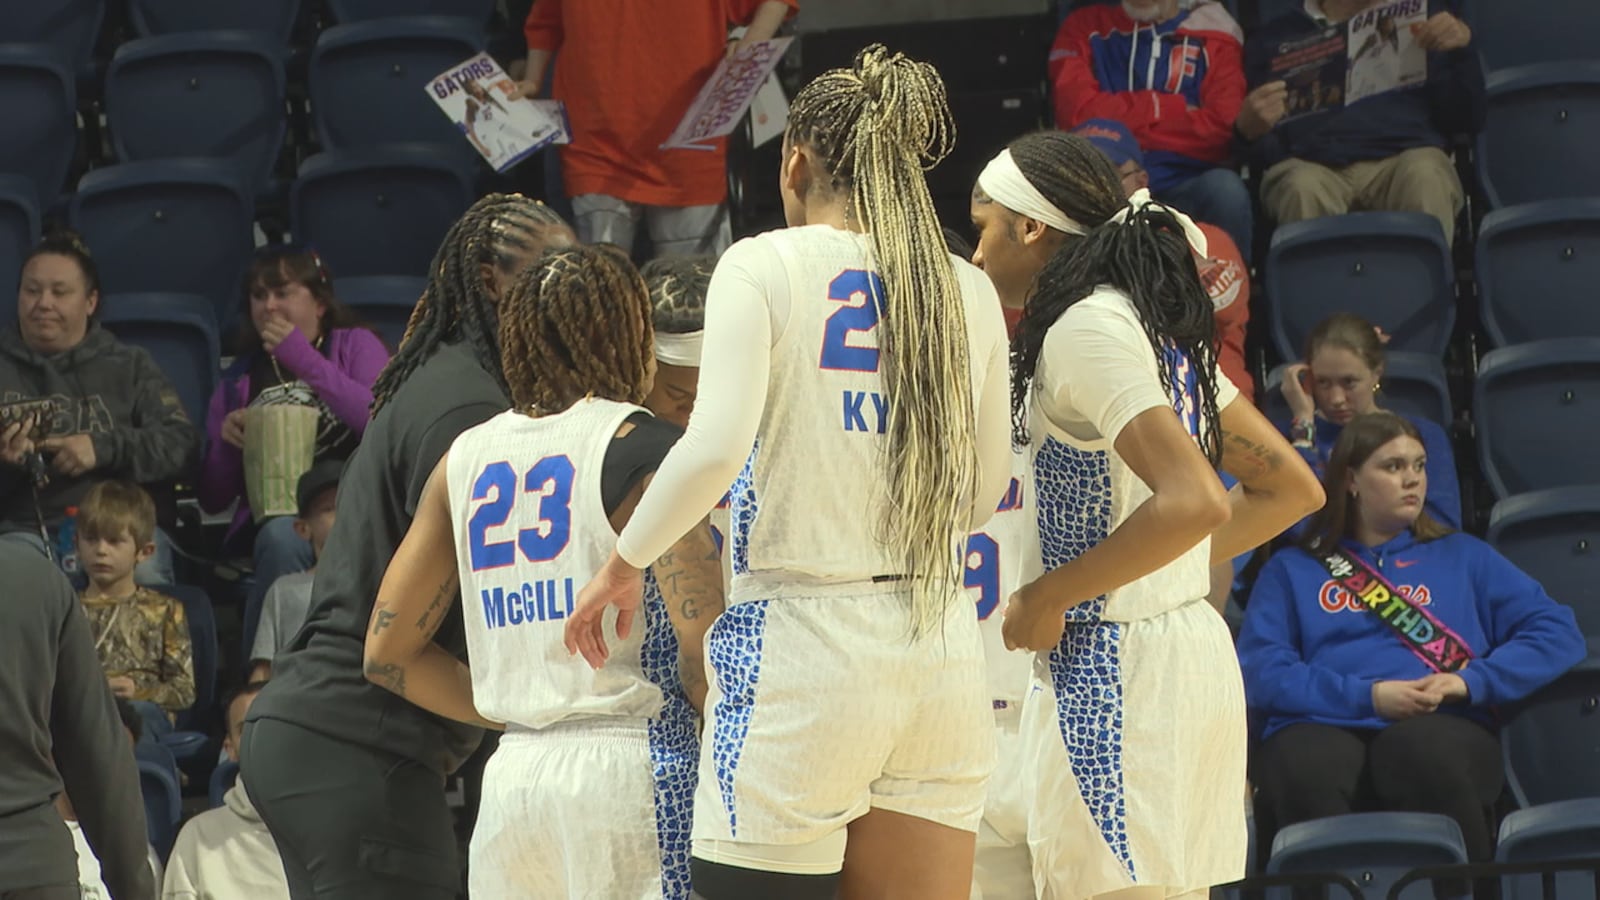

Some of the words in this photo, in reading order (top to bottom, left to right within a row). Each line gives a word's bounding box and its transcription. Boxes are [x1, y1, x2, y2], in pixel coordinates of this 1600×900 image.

[1352, 0, 1421, 33] GATORS
[433, 58, 495, 99] GATORS
[1164, 45, 1201, 92] F
[468, 454, 576, 573] 23
[1342, 571, 1467, 669] BIRTHDAY
